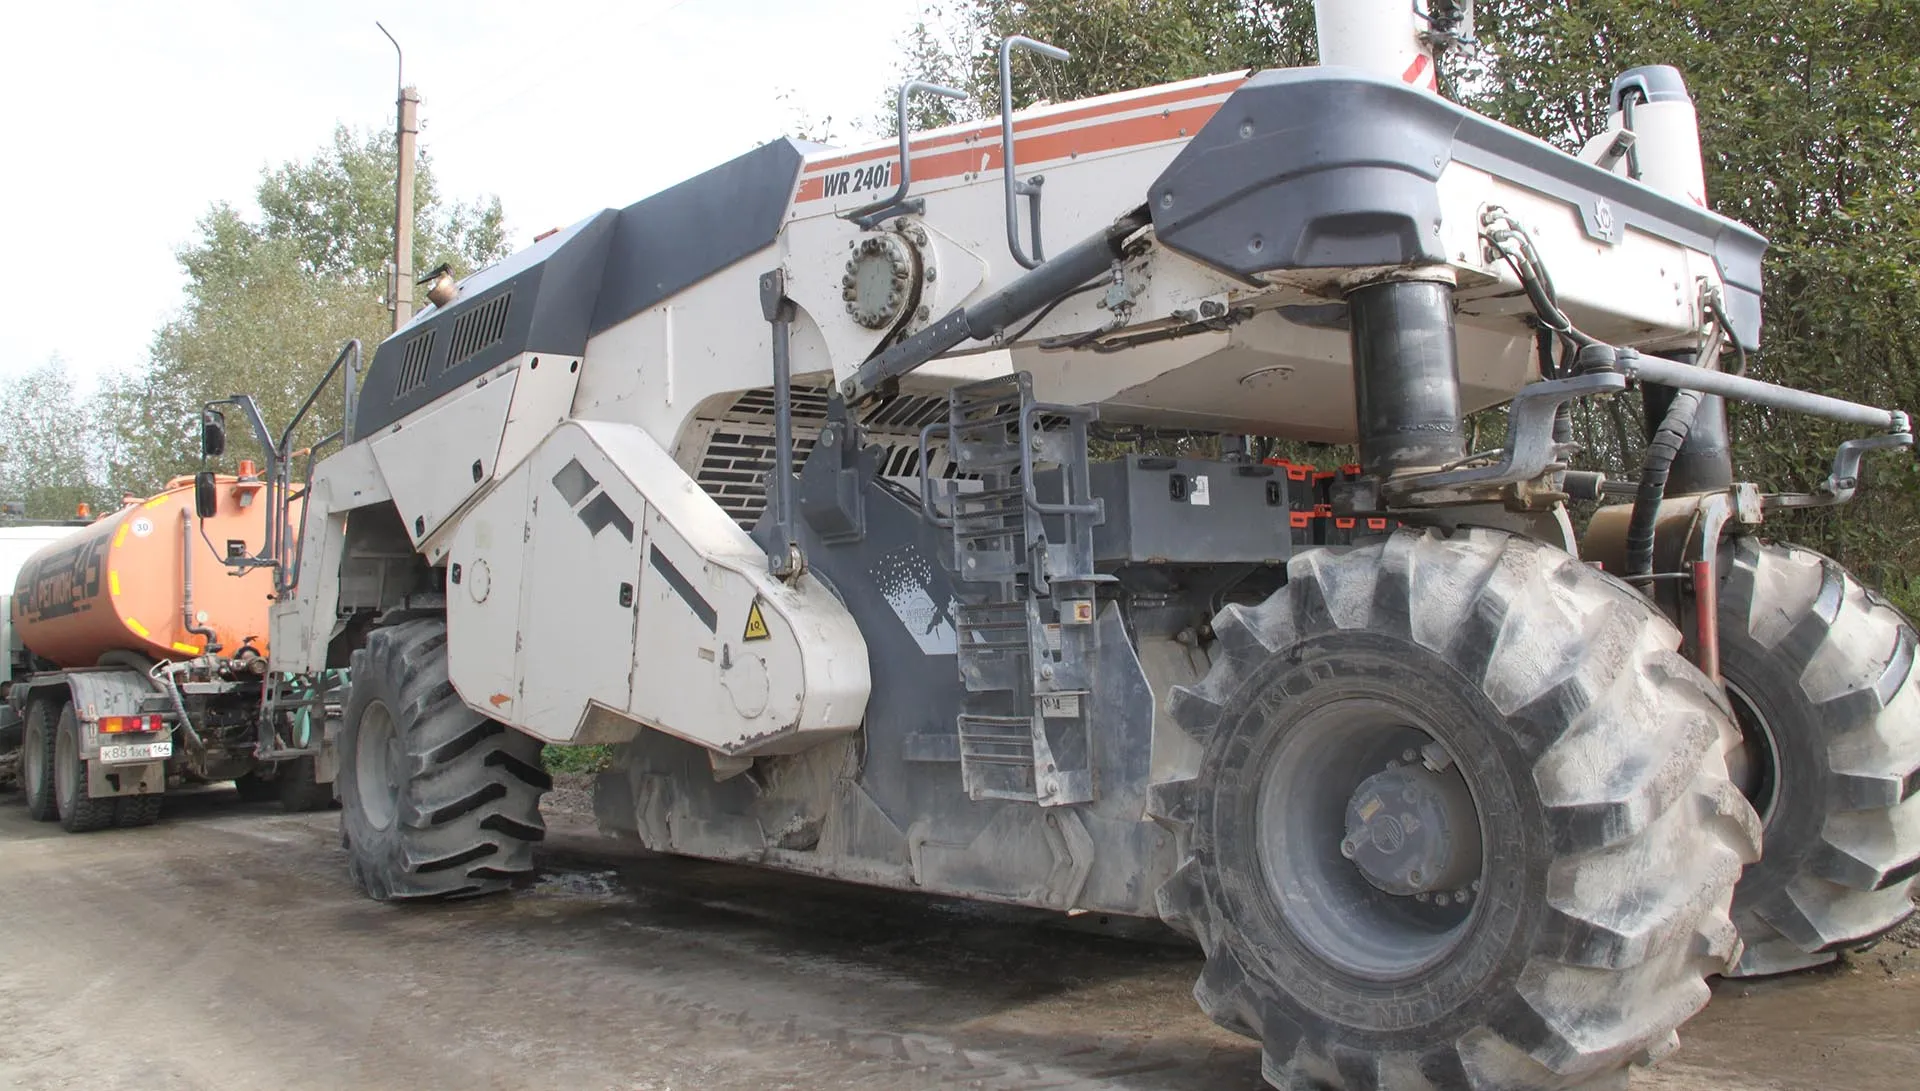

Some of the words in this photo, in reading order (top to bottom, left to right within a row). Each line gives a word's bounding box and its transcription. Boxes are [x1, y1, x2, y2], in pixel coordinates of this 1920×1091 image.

[824, 171, 851, 198] WR
[852, 161, 891, 193] 240i
[136, 523, 149, 532] 30
